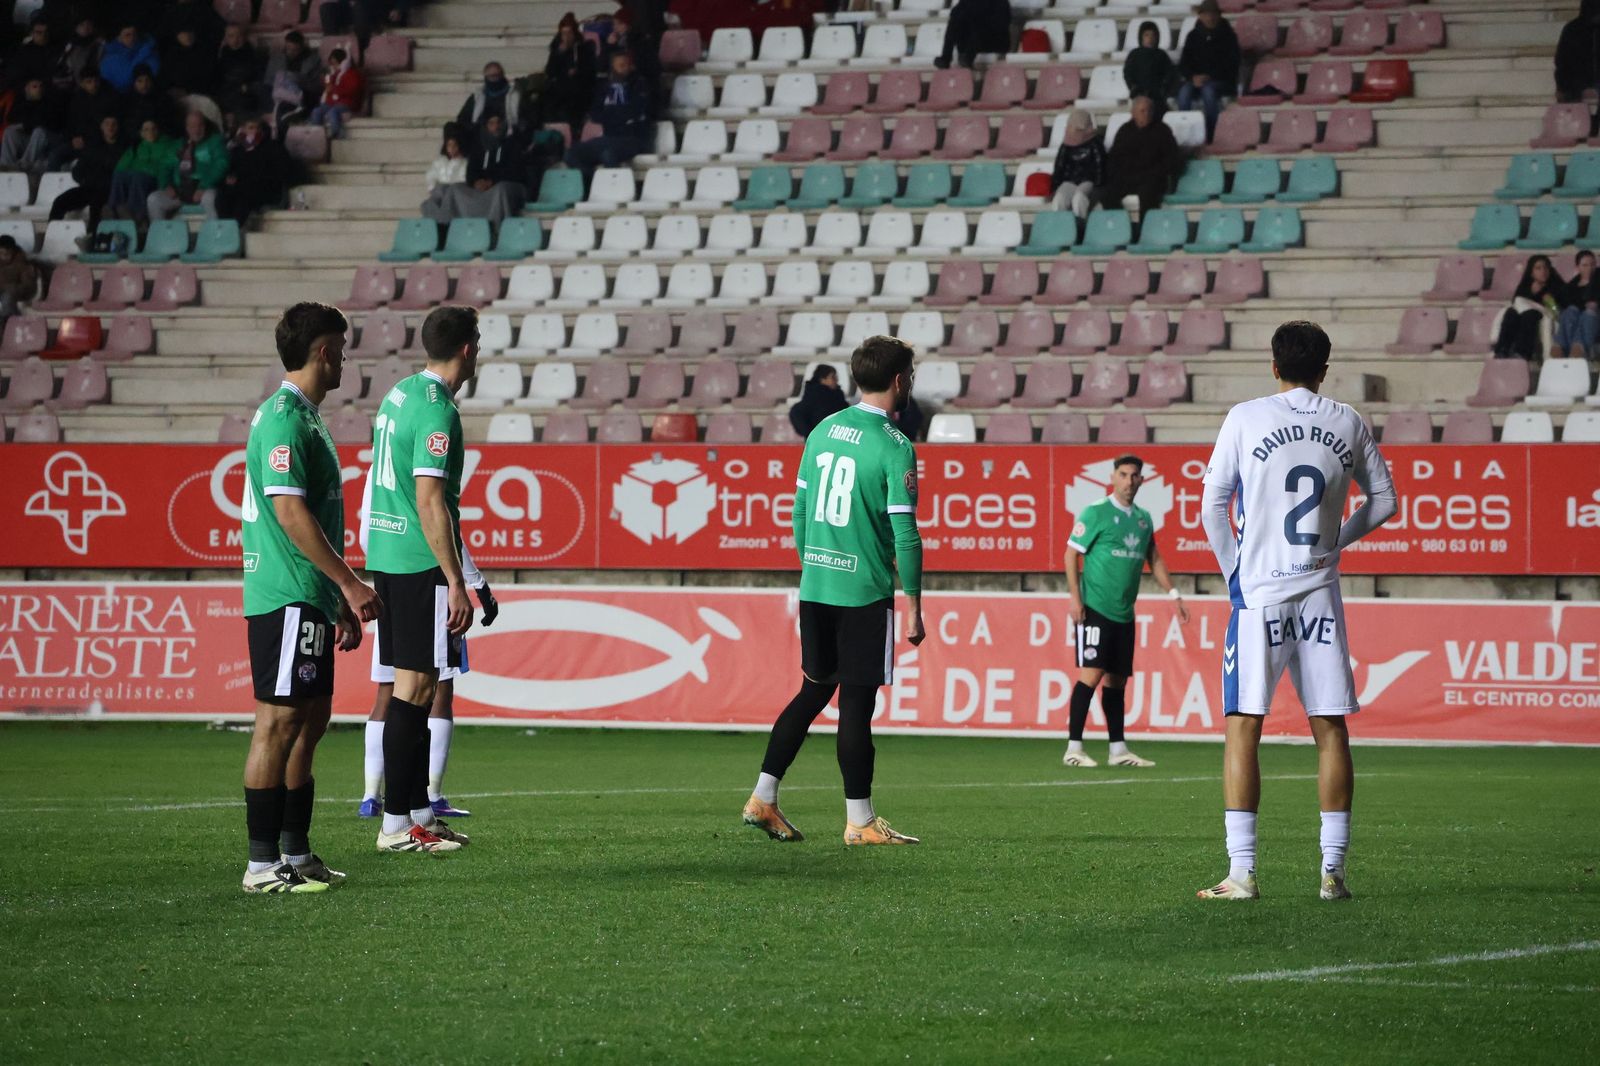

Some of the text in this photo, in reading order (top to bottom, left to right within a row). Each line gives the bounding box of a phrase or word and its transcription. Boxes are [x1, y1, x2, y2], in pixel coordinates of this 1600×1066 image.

[828, 424, 863, 445] FARRELL
[1252, 425, 1305, 463] DAVID
[815, 451, 856, 527] 18
[1284, 464, 1326, 546] 2
[718, 486, 1036, 529] tre uces
[719, 535, 768, 549] Zamora
[979, 537, 994, 550] 63
[998, 537, 1012, 550] 01
[1421, 539, 1446, 552] 980
[1450, 539, 1466, 552] 63
[1470, 539, 1485, 552] 01
[1490, 539, 1507, 552] 89
[1292, 563, 1313, 572] Islas
[0, 595, 196, 632] RNERA
[1029, 612, 1214, 649] DETAL
[300, 621, 325, 656] 20
[1085, 626, 1100, 646] 10
[942, 667, 1015, 724] DE
[1444, 690, 1600, 708] EL CENTRO COM
